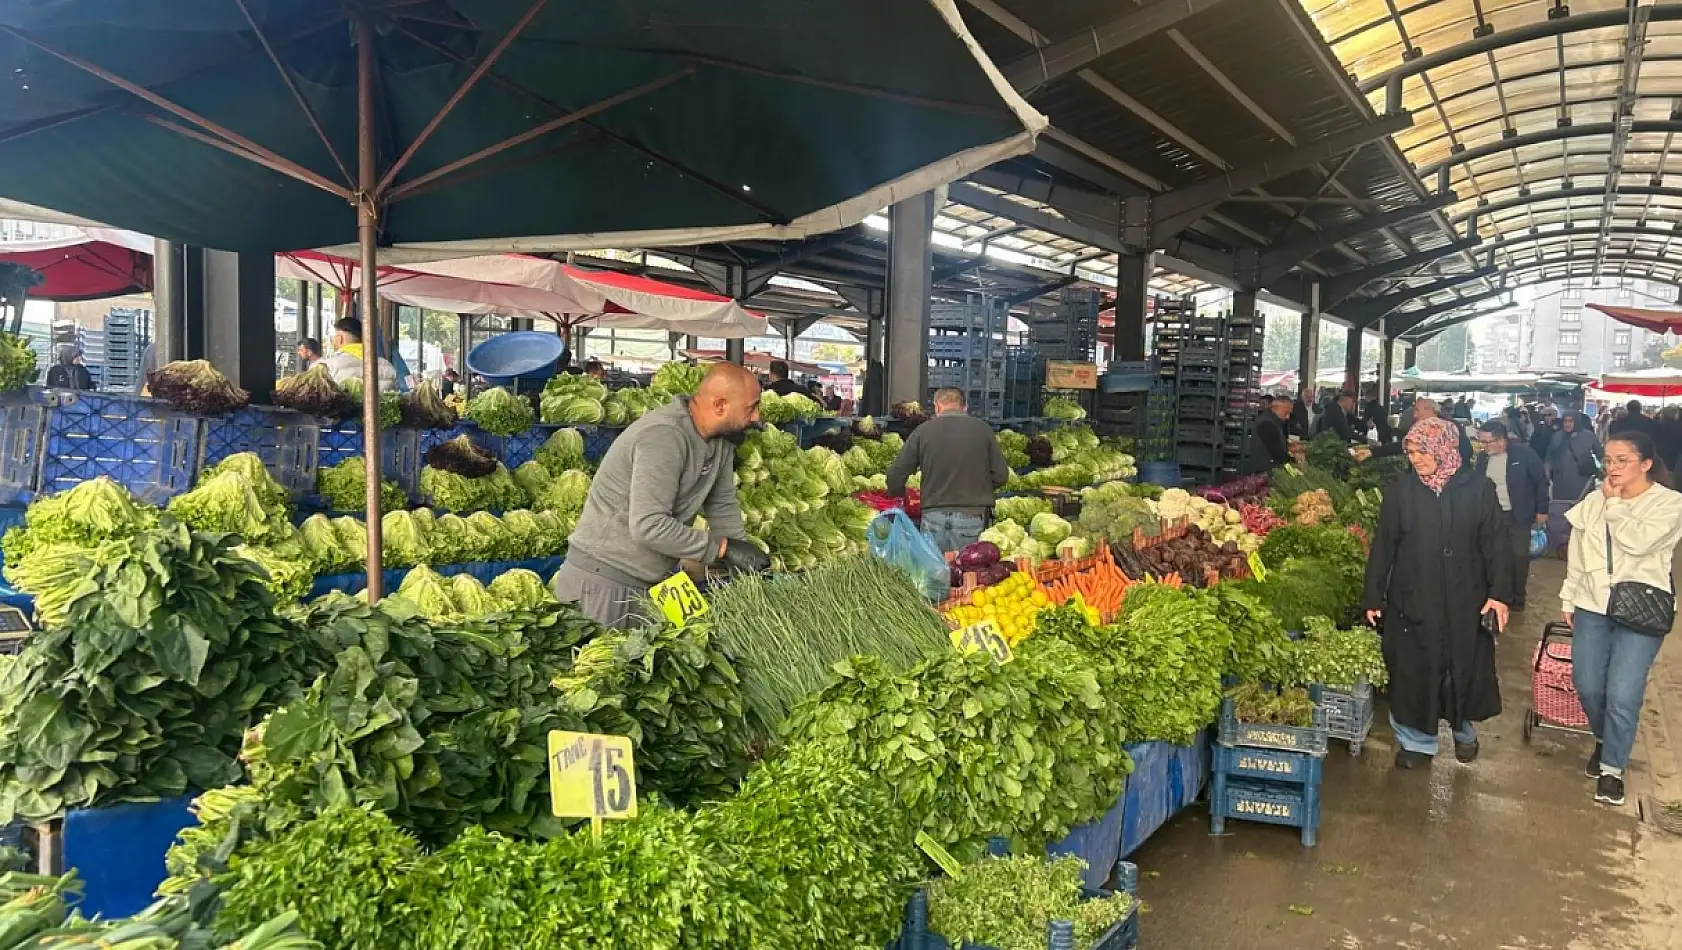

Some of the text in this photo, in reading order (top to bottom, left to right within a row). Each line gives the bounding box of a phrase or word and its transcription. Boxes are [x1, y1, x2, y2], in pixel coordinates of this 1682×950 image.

[670, 582, 702, 620] 25
[972, 624, 1008, 662] 15
[588, 738, 631, 816] 15
